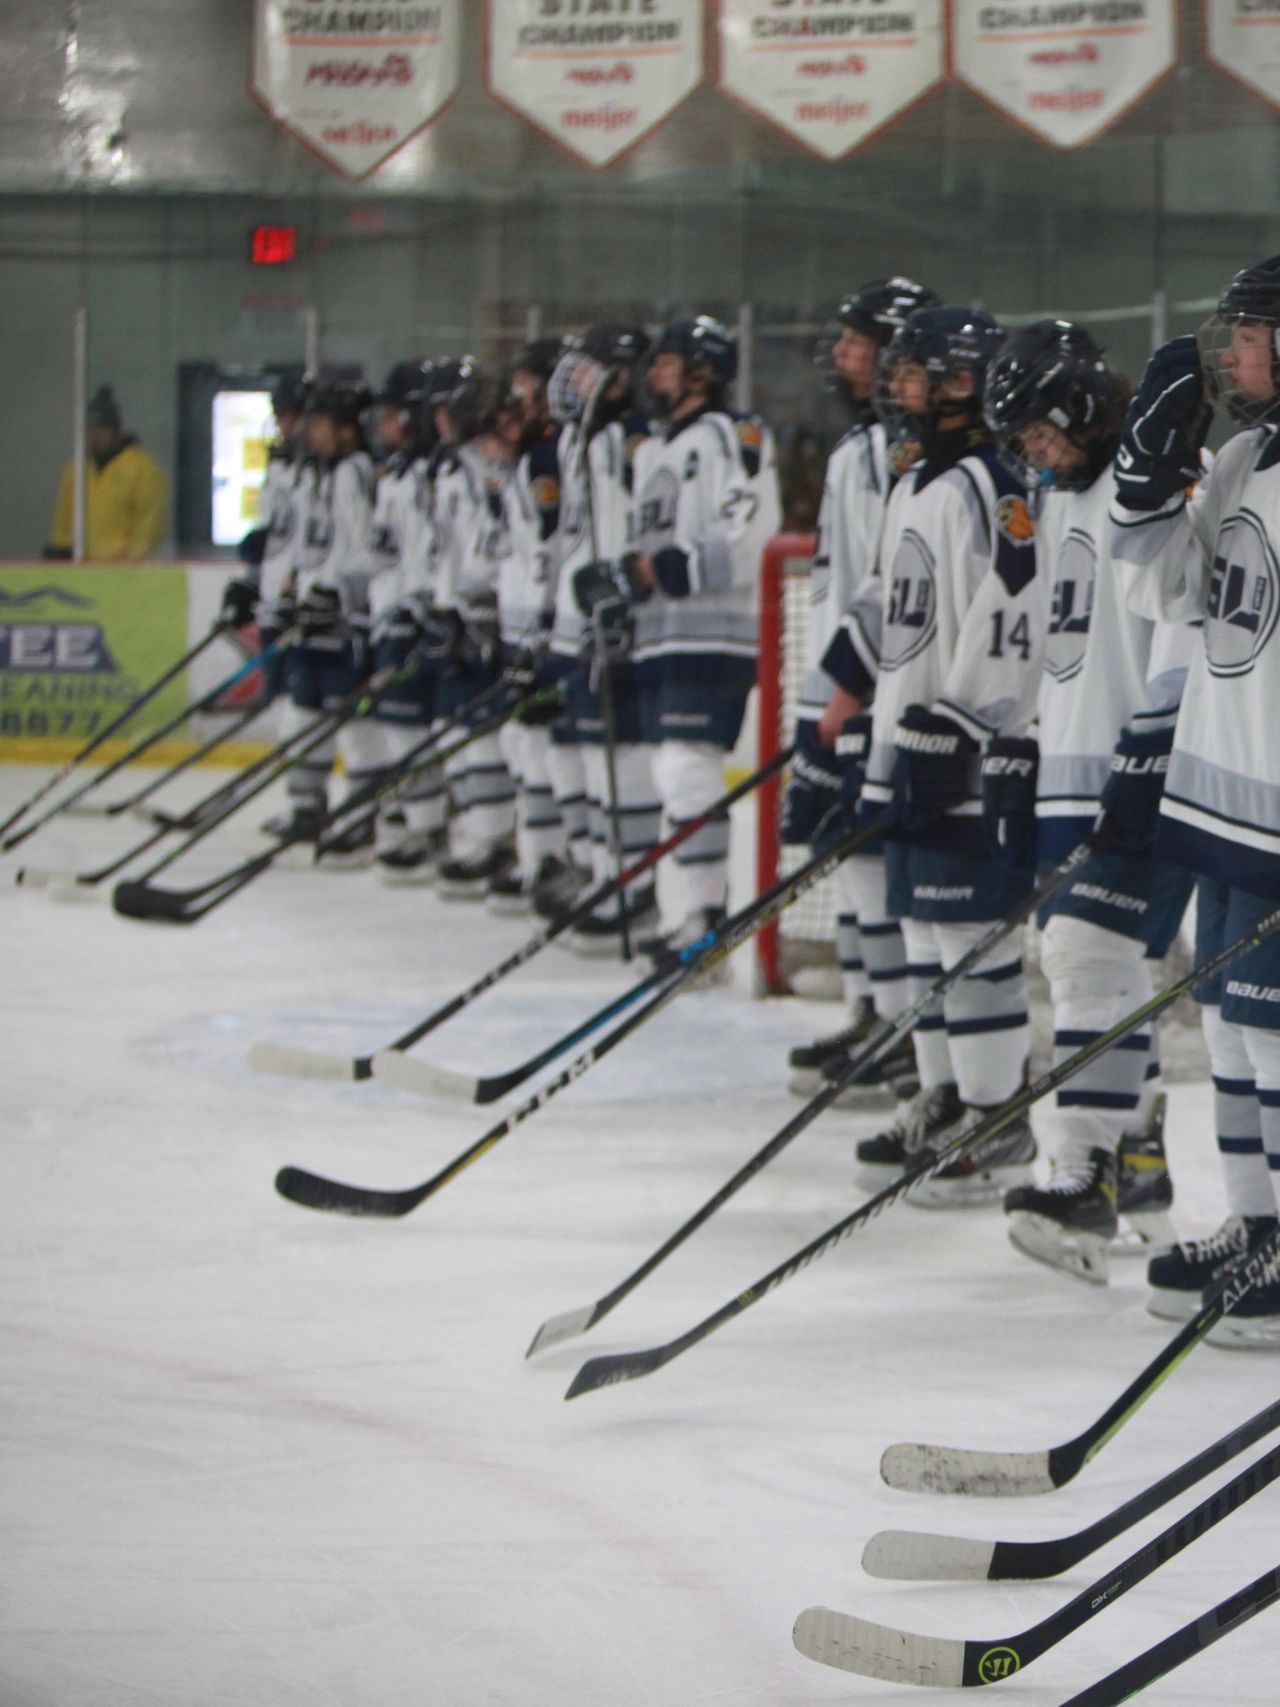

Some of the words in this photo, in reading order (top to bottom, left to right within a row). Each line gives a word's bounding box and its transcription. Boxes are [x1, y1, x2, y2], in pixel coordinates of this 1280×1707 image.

[518, 19, 680, 45] CHAMPION
[752, 14, 914, 38] CHAMPION
[0, 624, 100, 669] EE
[988, 609, 1031, 661] 14
[981, 755, 1033, 778] ER
[1070, 881, 1148, 915] BAUER
